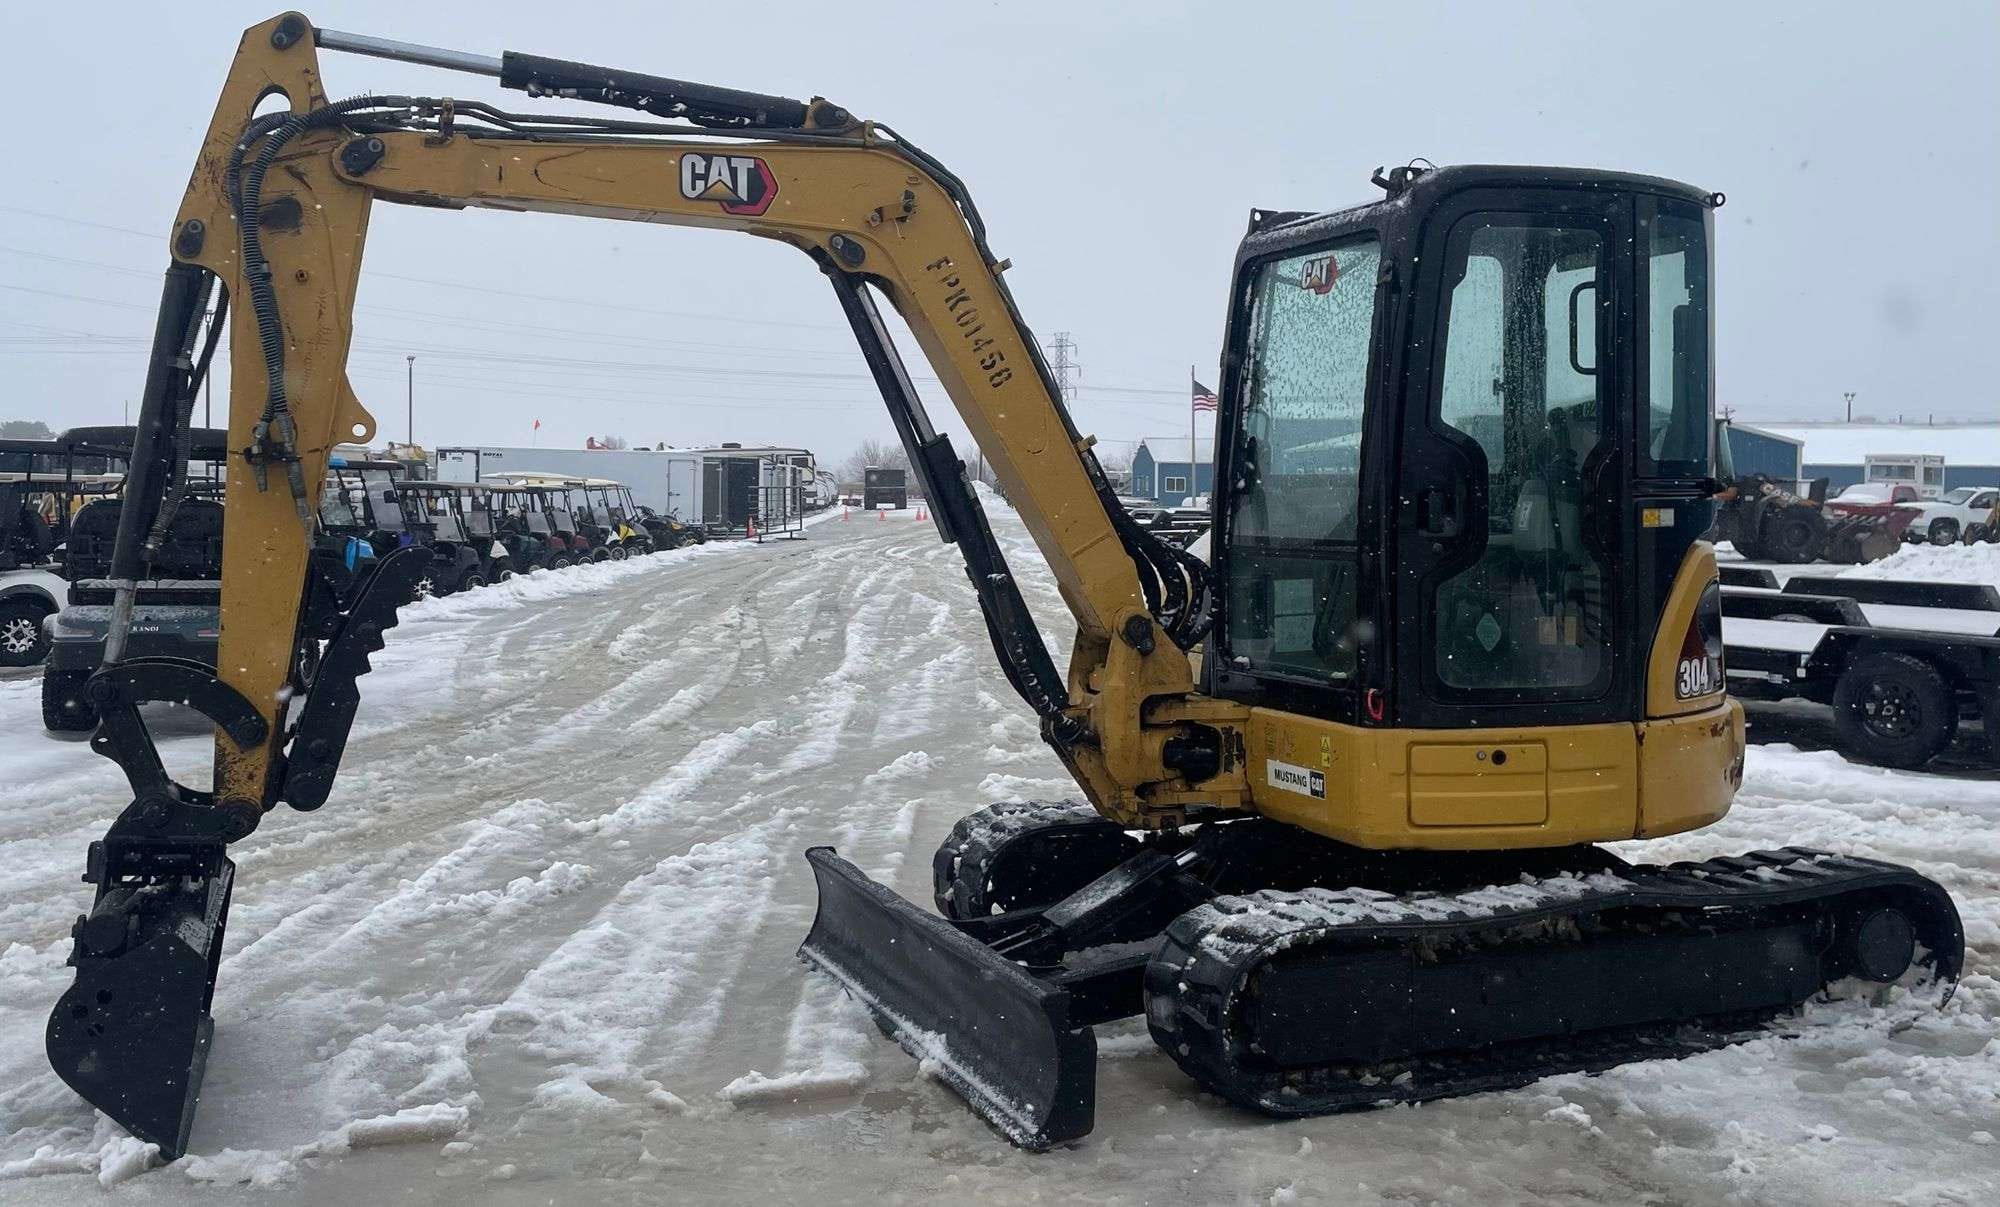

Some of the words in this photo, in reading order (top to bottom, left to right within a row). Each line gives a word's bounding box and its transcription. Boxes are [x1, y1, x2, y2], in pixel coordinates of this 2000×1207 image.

[680, 153, 755, 202] CAT
[1301, 257, 1332, 289] CAT
[1680, 656, 1709, 696] 304
[1274, 768, 1308, 787] MUSTANG
[1310, 776, 1324, 792] CAT
